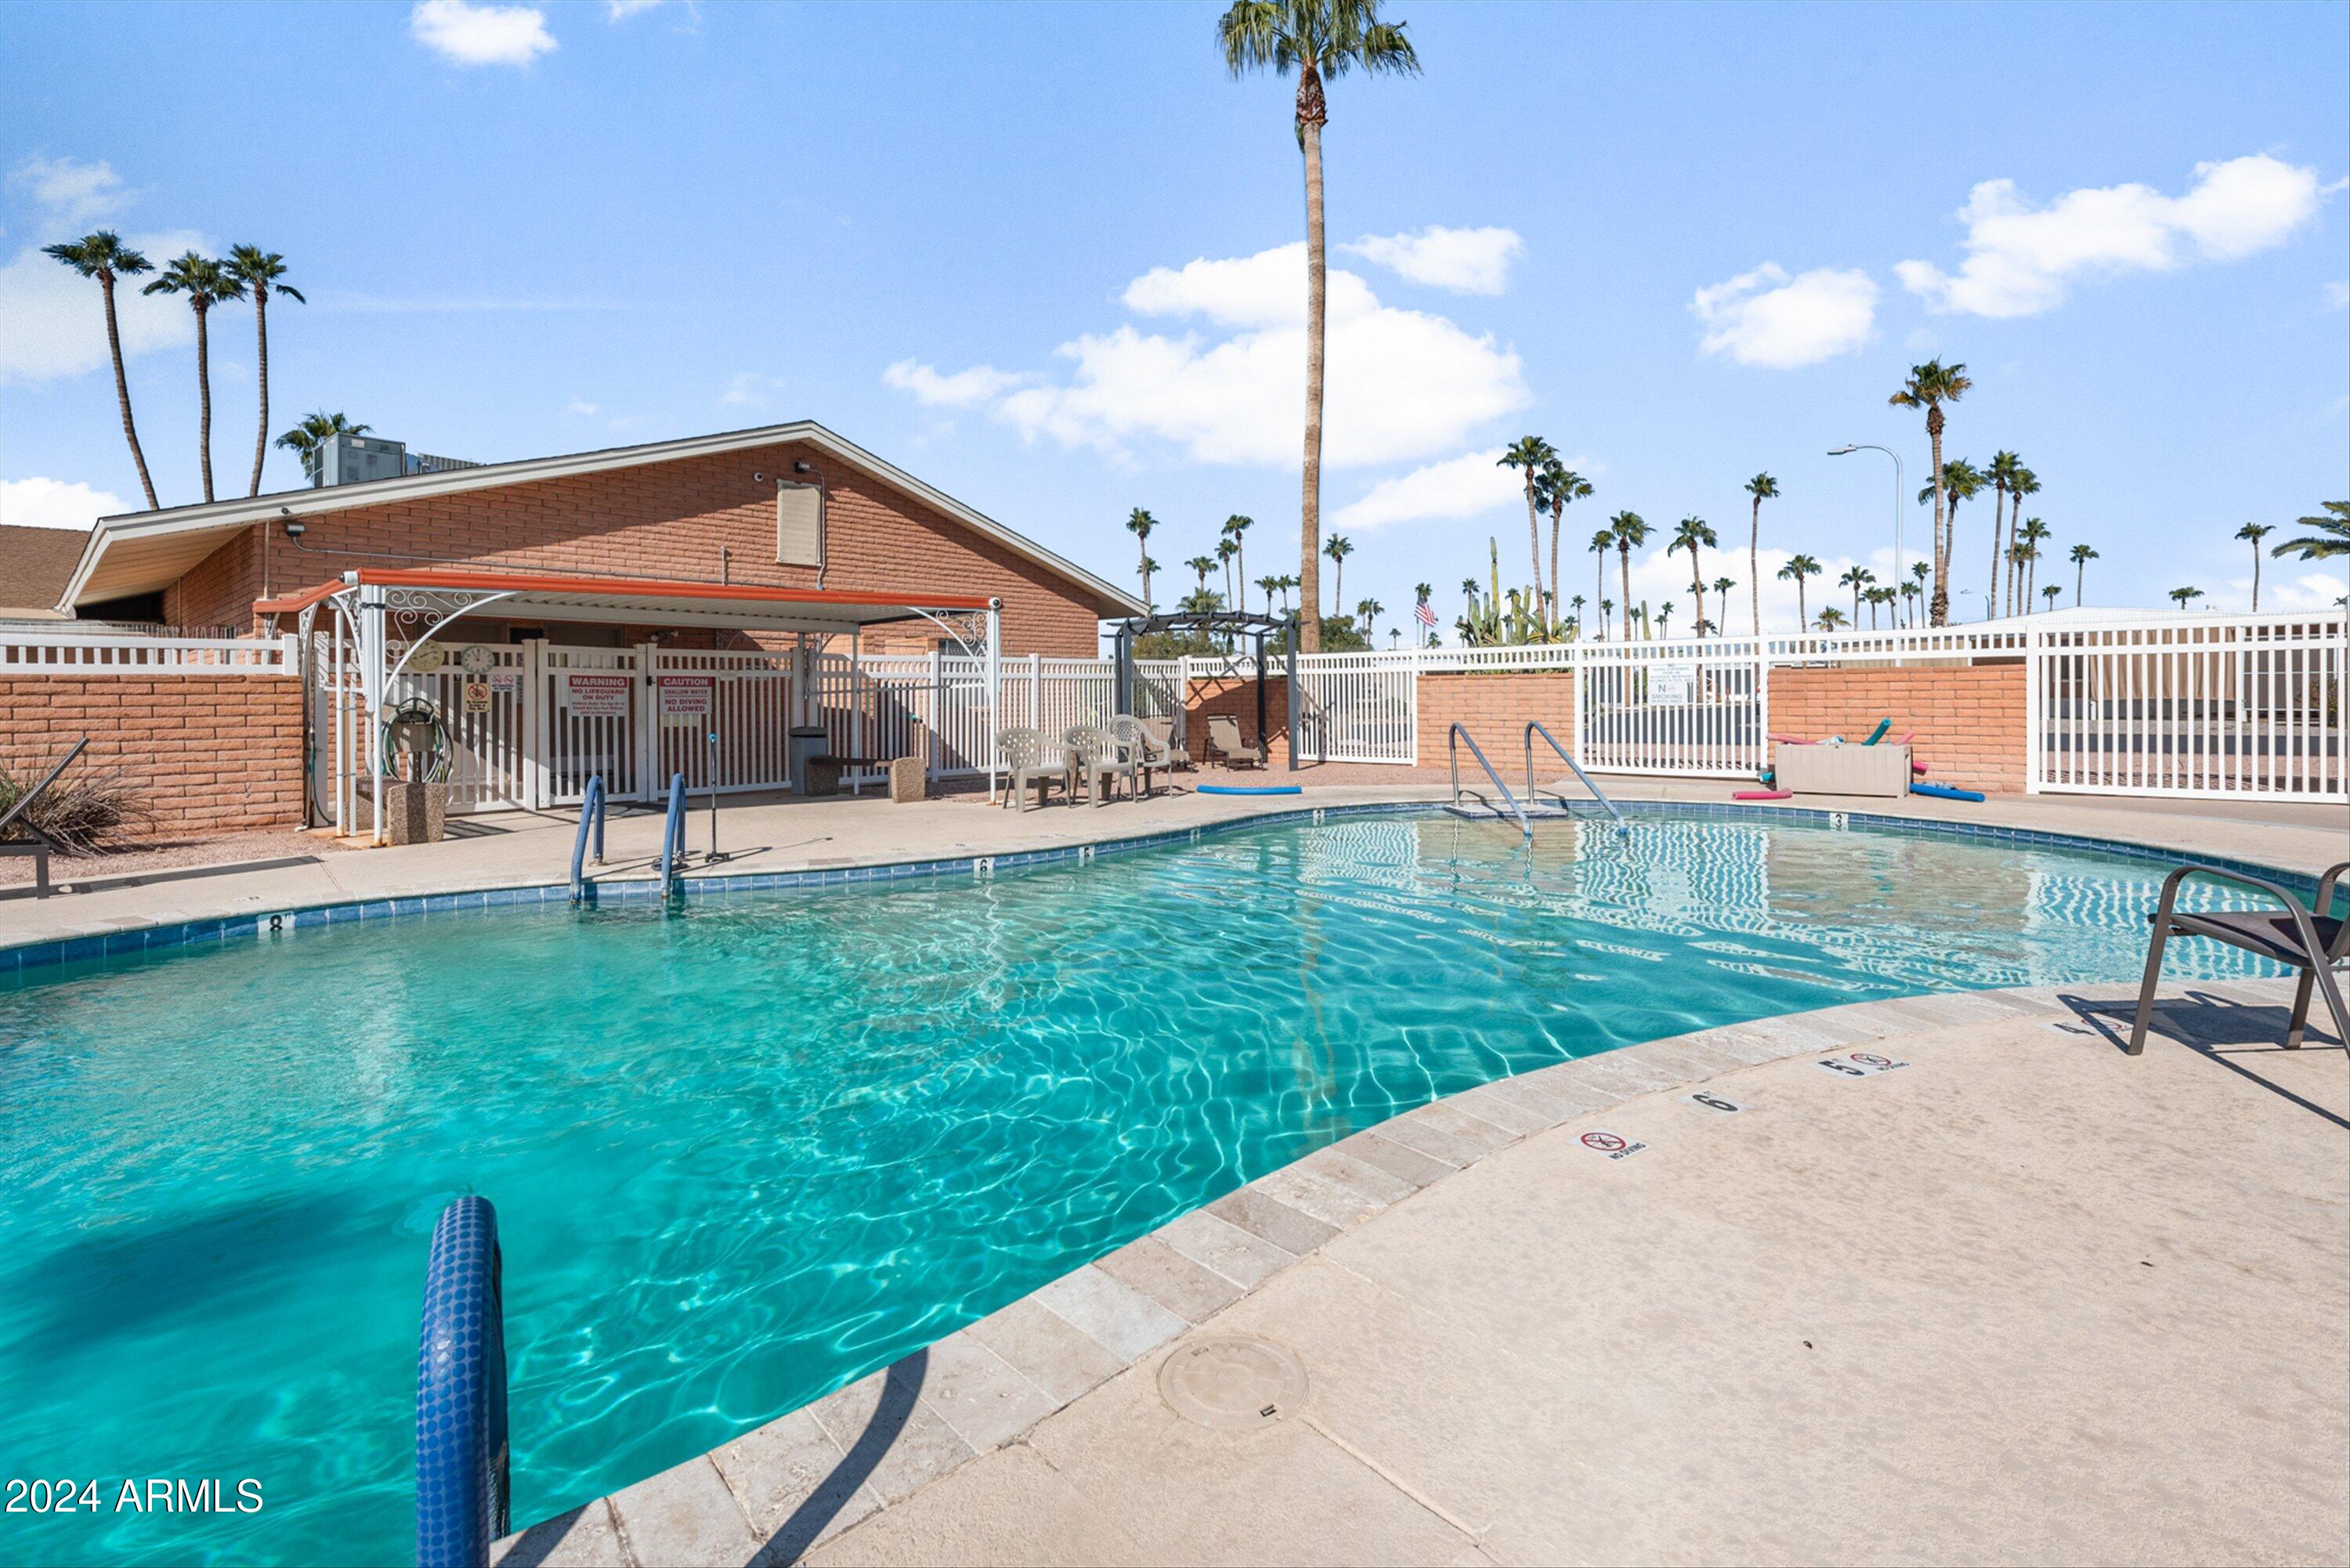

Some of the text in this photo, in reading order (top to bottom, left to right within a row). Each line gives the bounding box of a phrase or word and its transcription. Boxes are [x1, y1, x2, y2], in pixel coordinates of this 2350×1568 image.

[572, 677, 625, 686] WARNING
[980, 858, 988, 873] 6
[1817, 1060, 1865, 1076] 5
[1692, 1094, 1738, 1111] 6
